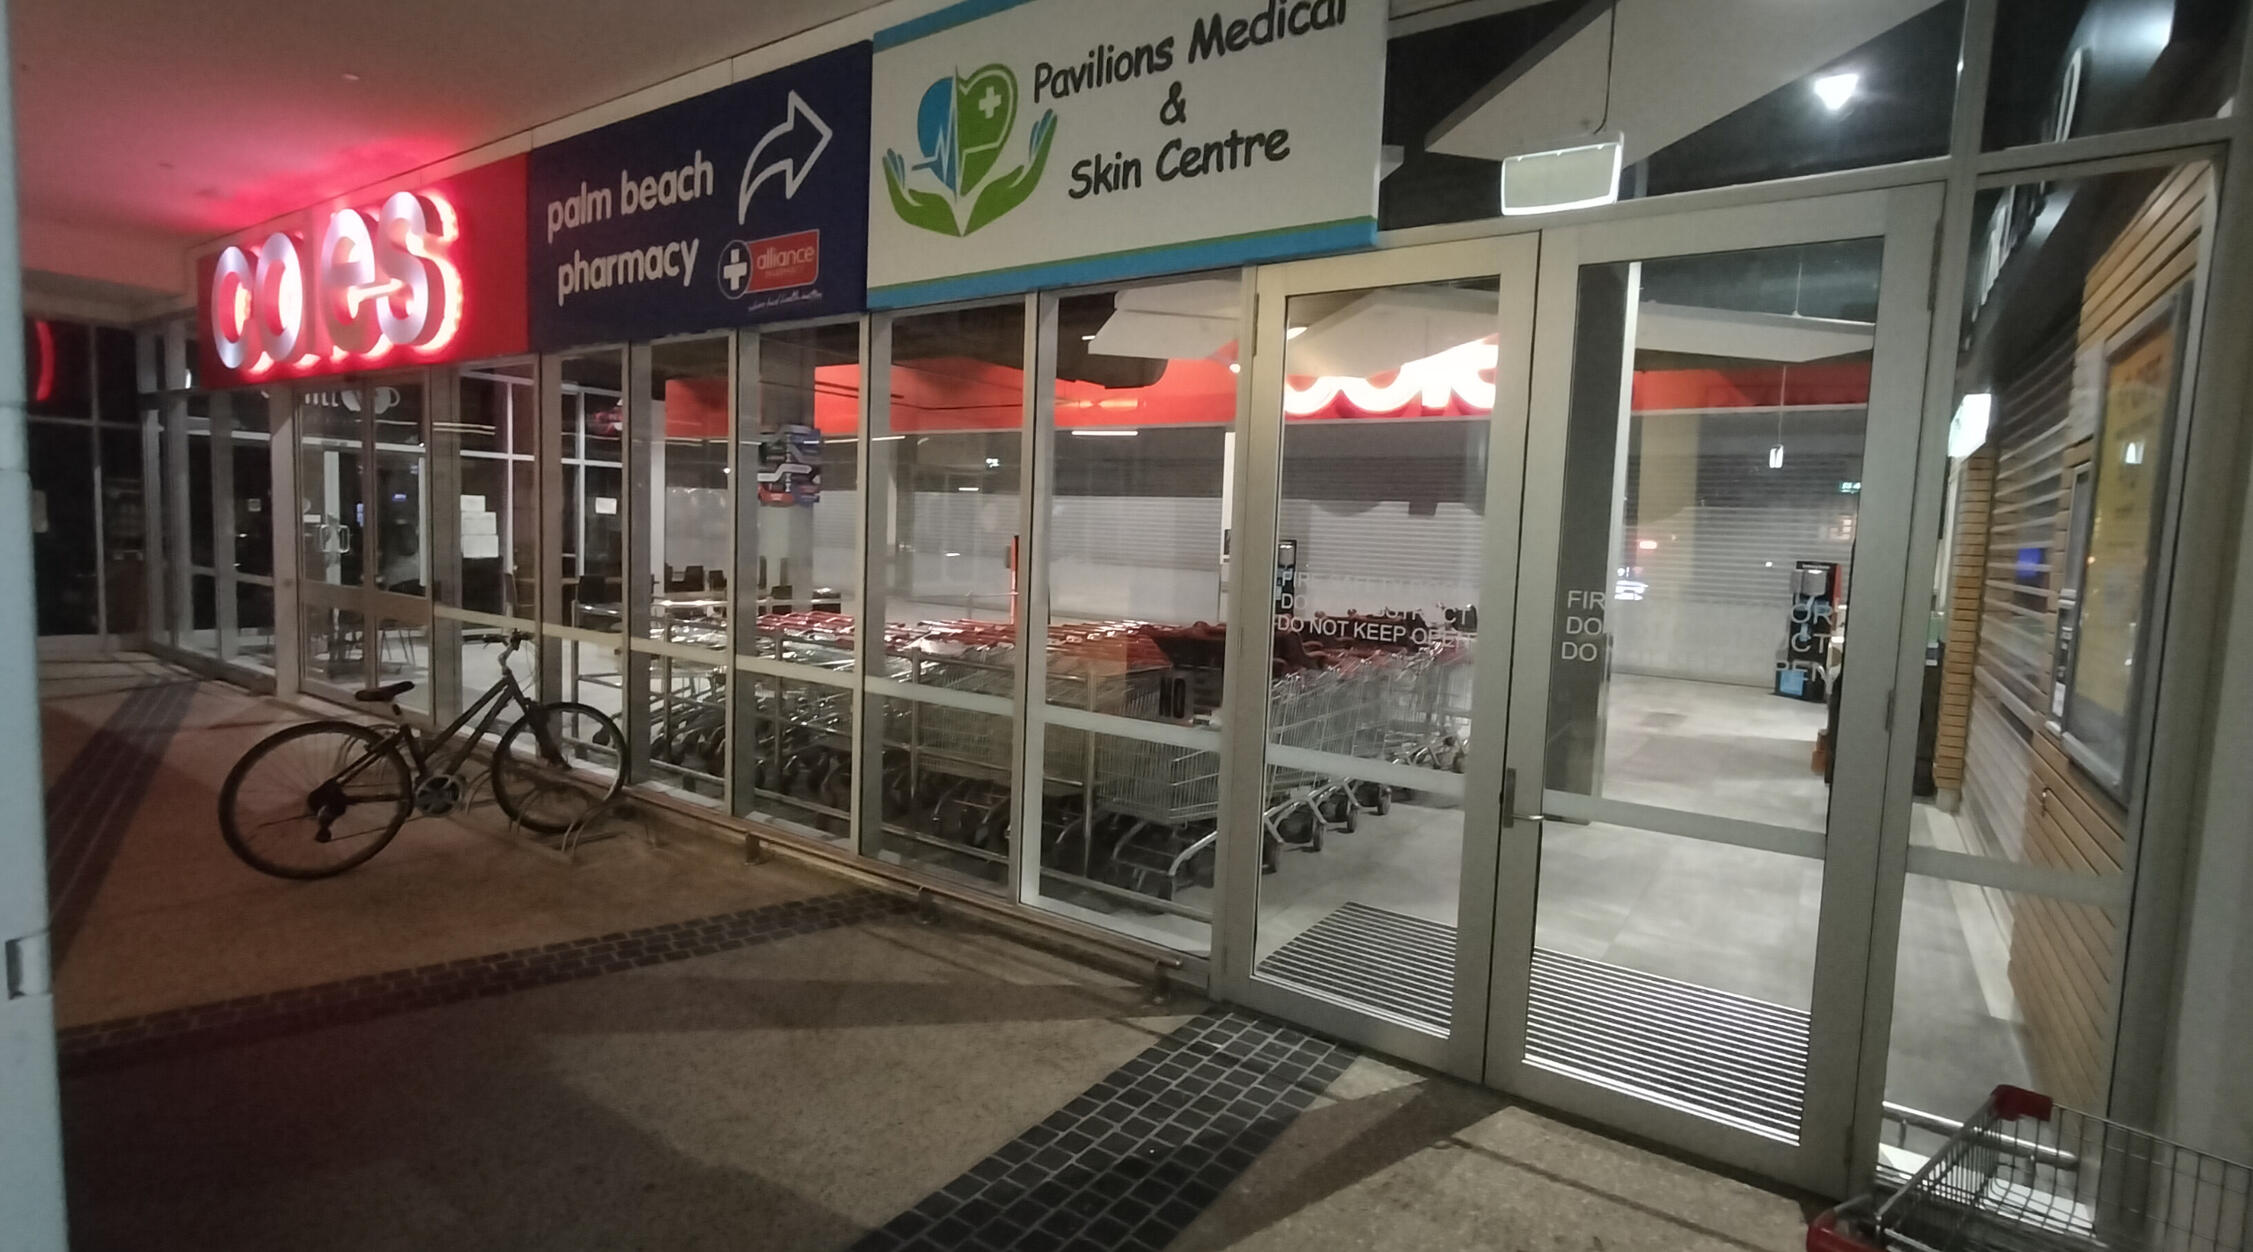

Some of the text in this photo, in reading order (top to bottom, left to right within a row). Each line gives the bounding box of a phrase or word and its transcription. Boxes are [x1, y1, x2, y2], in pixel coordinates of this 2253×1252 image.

[1034, 0, 1347, 103] Pavilions Medical
[1160, 80, 1187, 125] &
[1068, 129, 1291, 199] Skin Centre
[548, 149, 714, 244] palm beach
[558, 238, 699, 307] pharmacy
[756, 246, 816, 270] alliance
[1565, 615, 1603, 636] DO
[1566, 589, 1834, 624] FIR OR
[1277, 614, 1305, 632] DO
[1308, 619, 1349, 637] NOT
[1353, 622, 1406, 643] KEEP
[1561, 641, 1598, 662] DO
